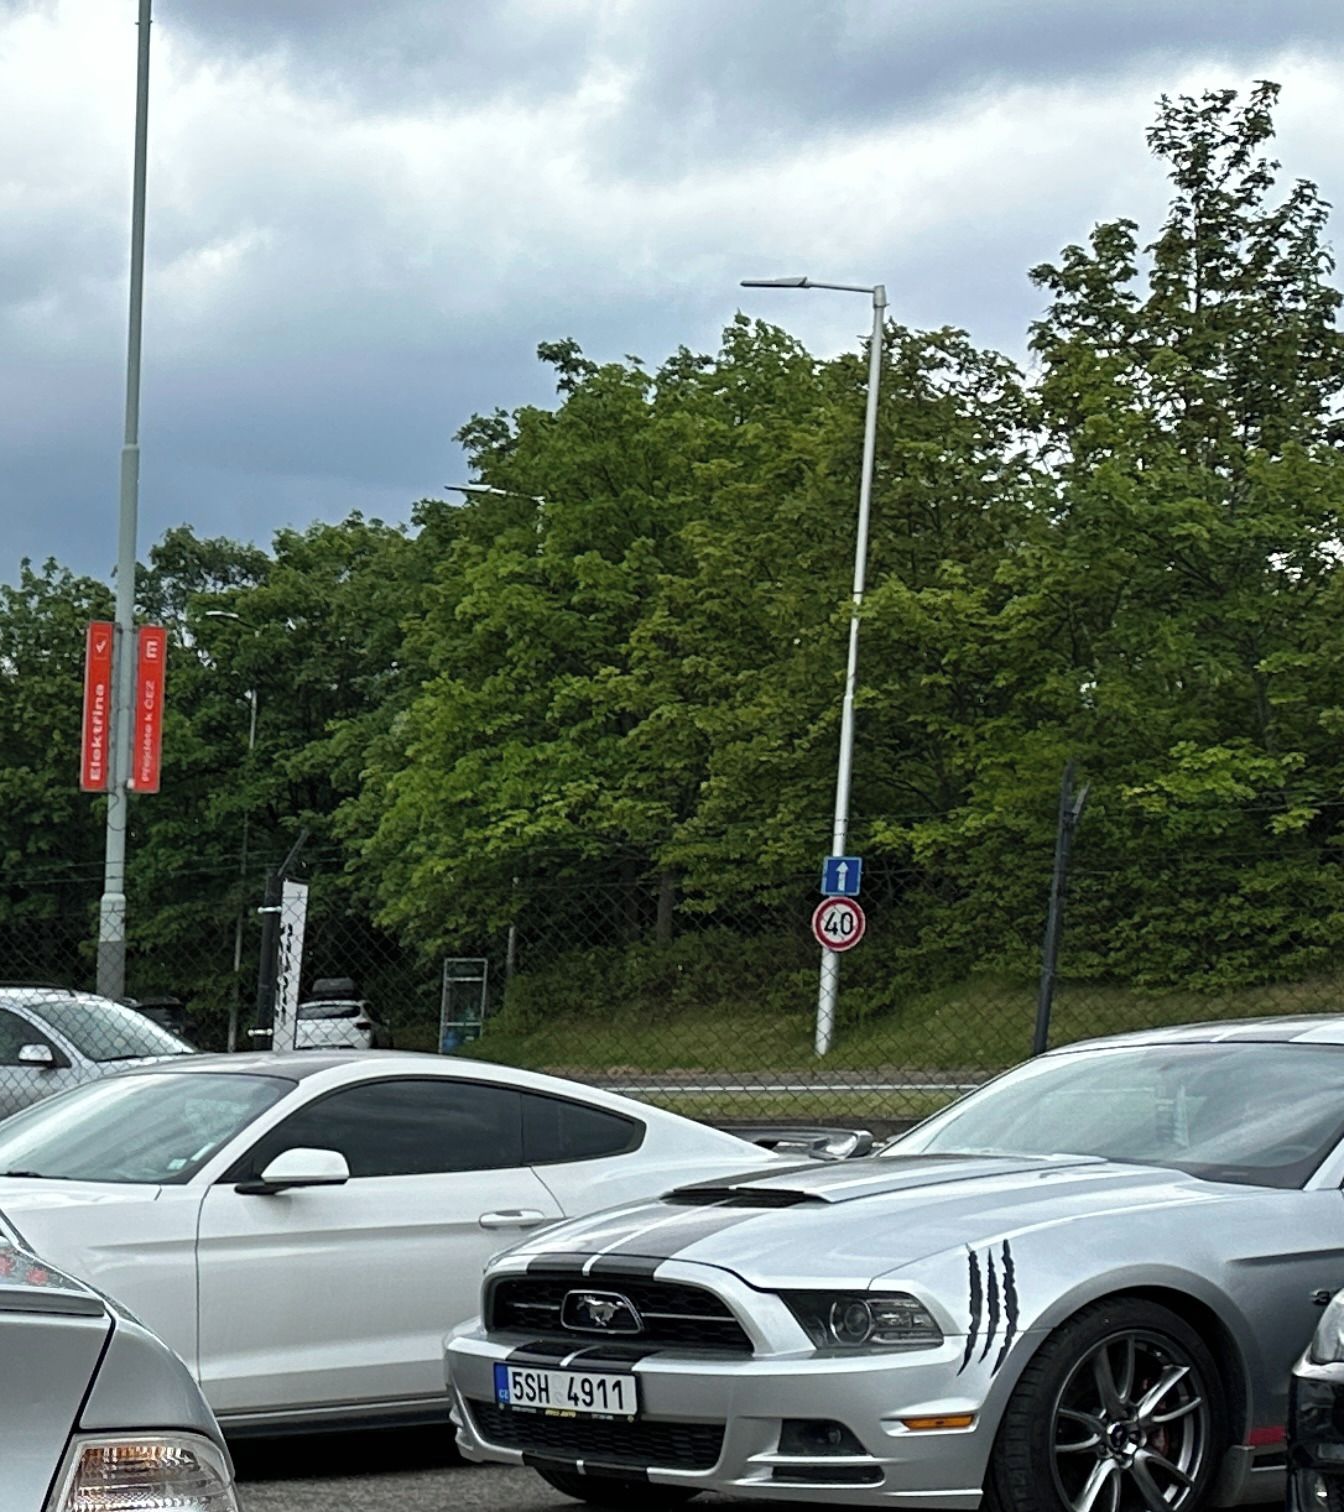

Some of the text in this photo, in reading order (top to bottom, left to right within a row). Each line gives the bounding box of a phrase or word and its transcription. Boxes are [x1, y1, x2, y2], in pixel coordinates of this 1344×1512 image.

[90, 684, 105, 781] Elektřina
[144, 713, 153, 721] k
[823, 911, 855, 936] 40
[511, 1371, 551, 1404] 5SH
[567, 1376, 624, 1410] 4911
